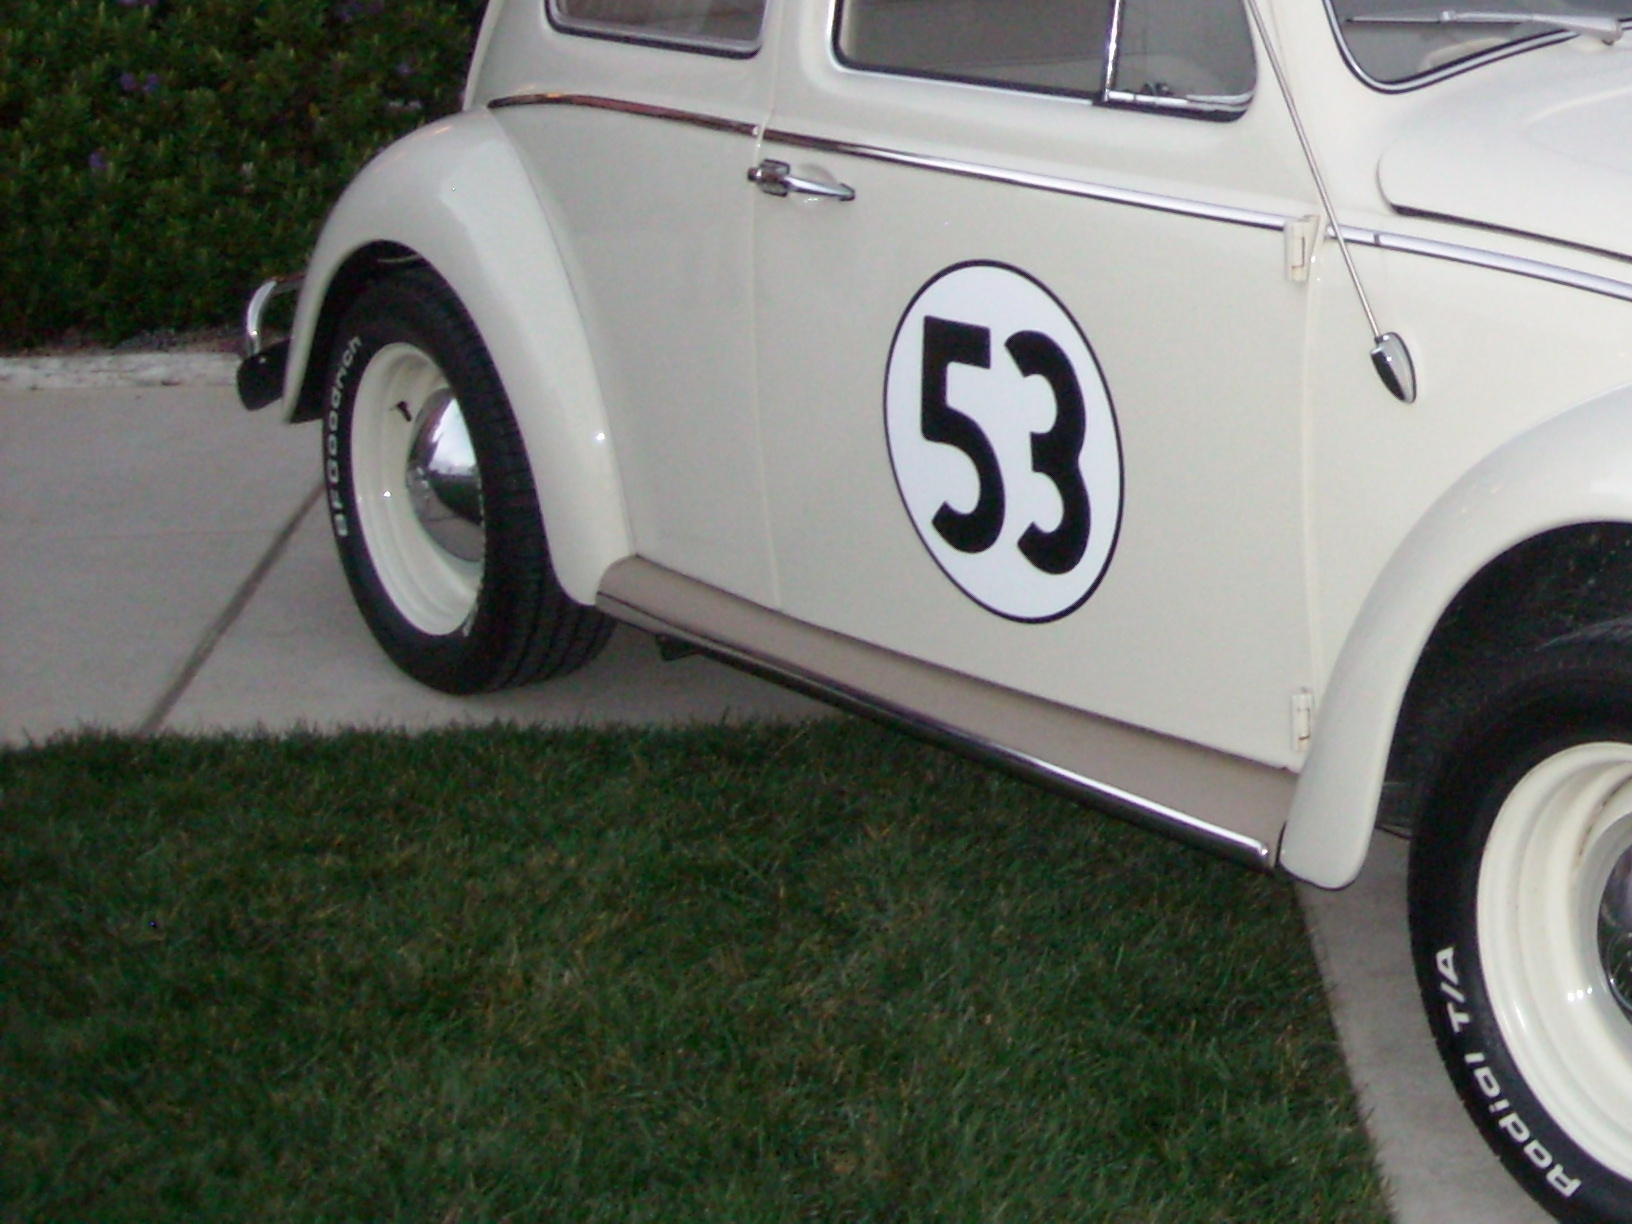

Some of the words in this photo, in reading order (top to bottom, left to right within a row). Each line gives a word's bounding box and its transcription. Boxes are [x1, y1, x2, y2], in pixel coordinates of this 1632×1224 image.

[921, 315, 1091, 575] 53
[1434, 945, 1473, 1034] T/A
[1466, 1050, 1583, 1199] Radial
